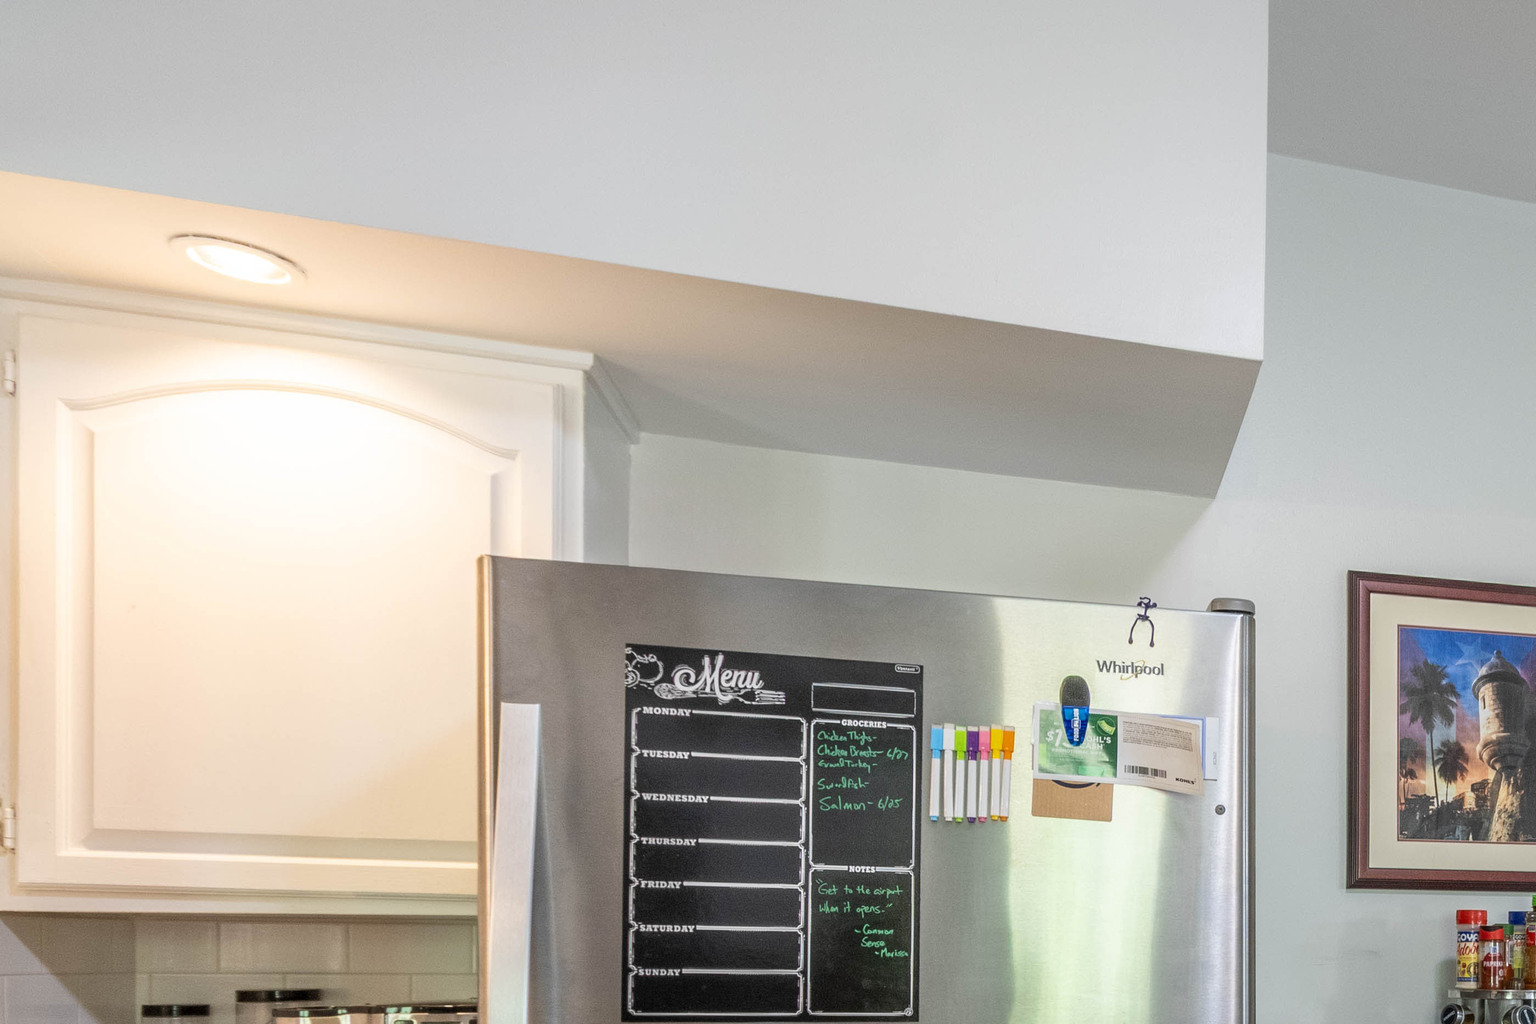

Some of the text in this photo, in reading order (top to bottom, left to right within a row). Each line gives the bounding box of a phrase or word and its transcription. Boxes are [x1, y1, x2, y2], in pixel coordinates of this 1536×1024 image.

[1096, 660, 1164, 678] Whirlpool
[672, 652, 764, 704] Menu
[642, 706, 691, 716] MONDAY
[841, 719, 887, 728] GROCERIES
[817, 730, 847, 741] Chicken
[642, 750, 690, 759] TUESDAY
[817, 744, 848, 756] Chicken
[642, 793, 709, 803] WEDNESDAY
[819, 795, 866, 811] Salmon
[877, 795, 903, 811] 6/25
[640, 837, 697, 846] THURSDAY
[640, 880, 681, 889] FRIDAY
[843, 884, 853, 894] to
[856, 884, 871, 895] the
[843, 901, 851, 913] it
[639, 924, 695, 933] SATURDAY
[861, 936, 886, 947] Sense
[638, 968, 680, 976] SUNDAY
